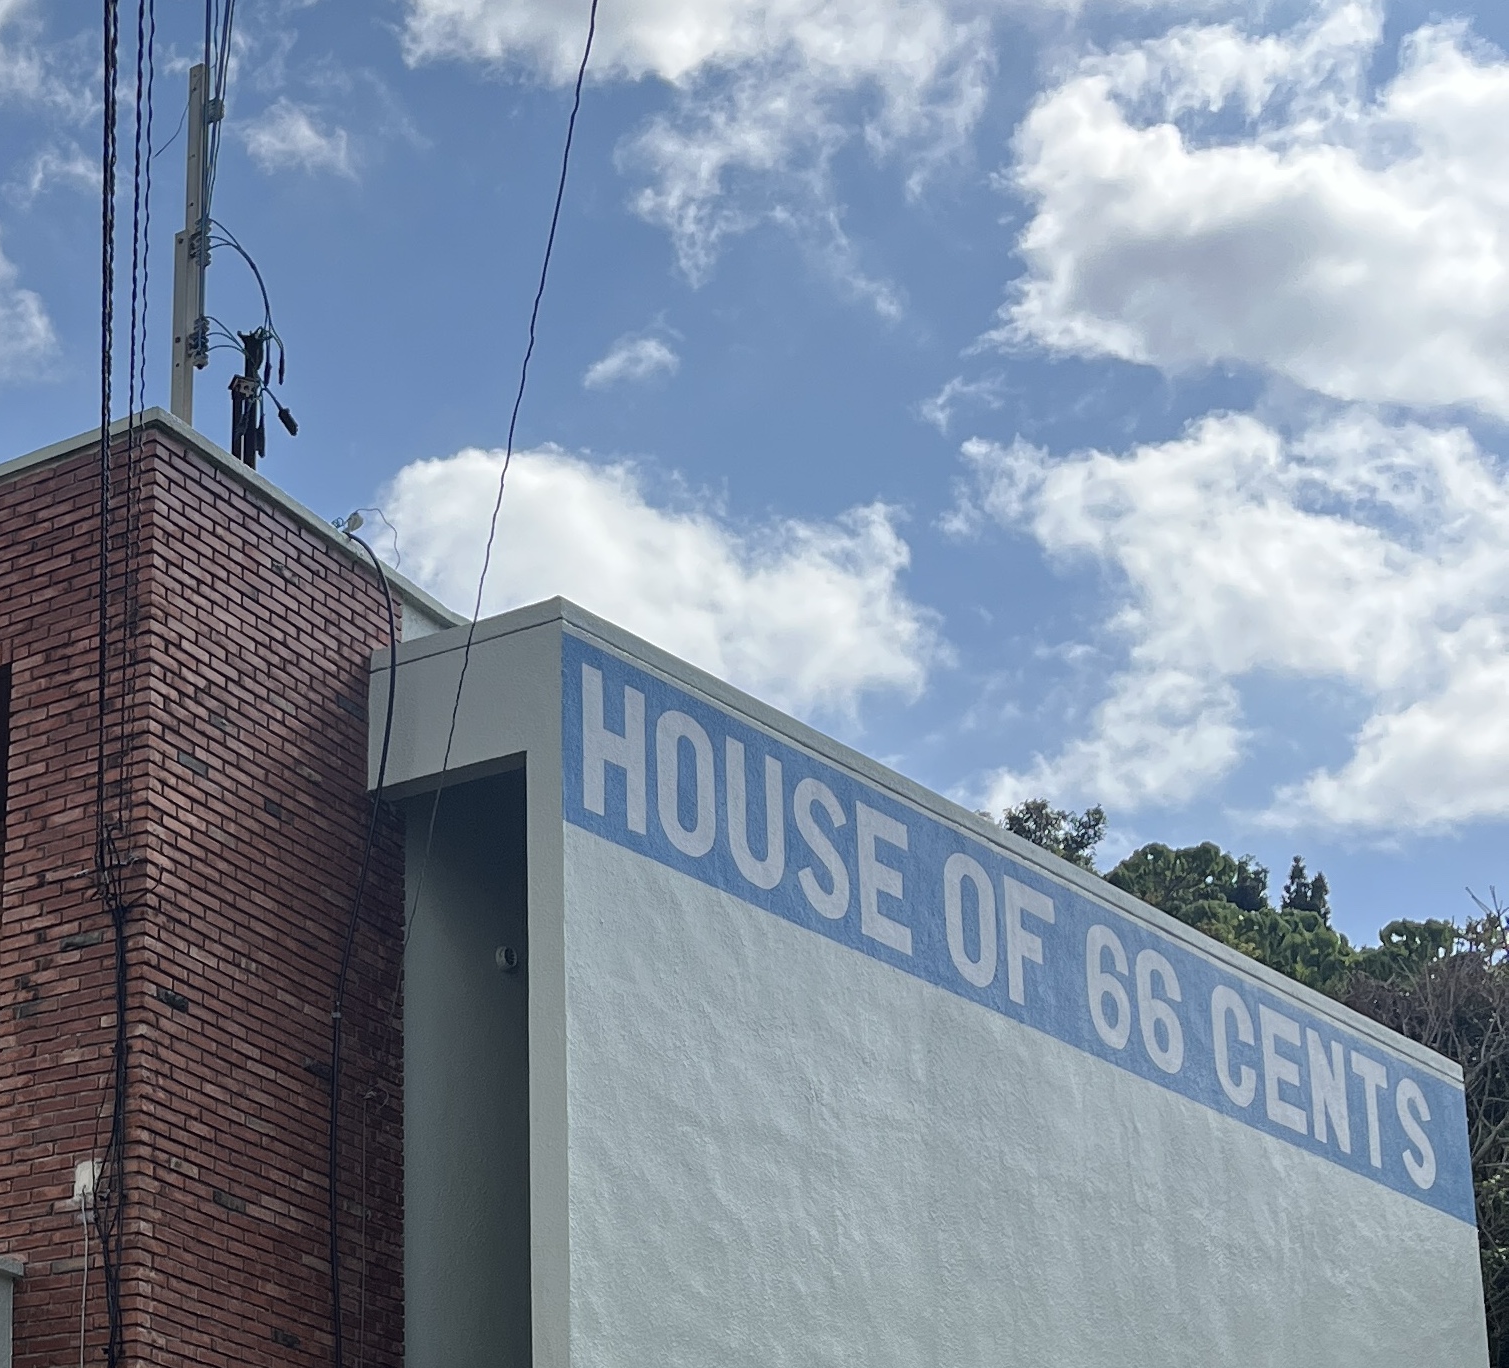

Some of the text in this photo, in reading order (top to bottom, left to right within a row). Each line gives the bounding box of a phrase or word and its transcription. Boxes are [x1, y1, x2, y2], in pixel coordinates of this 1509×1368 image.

[581, 663, 1438, 1190] HOUSE OF 66 CENTS
